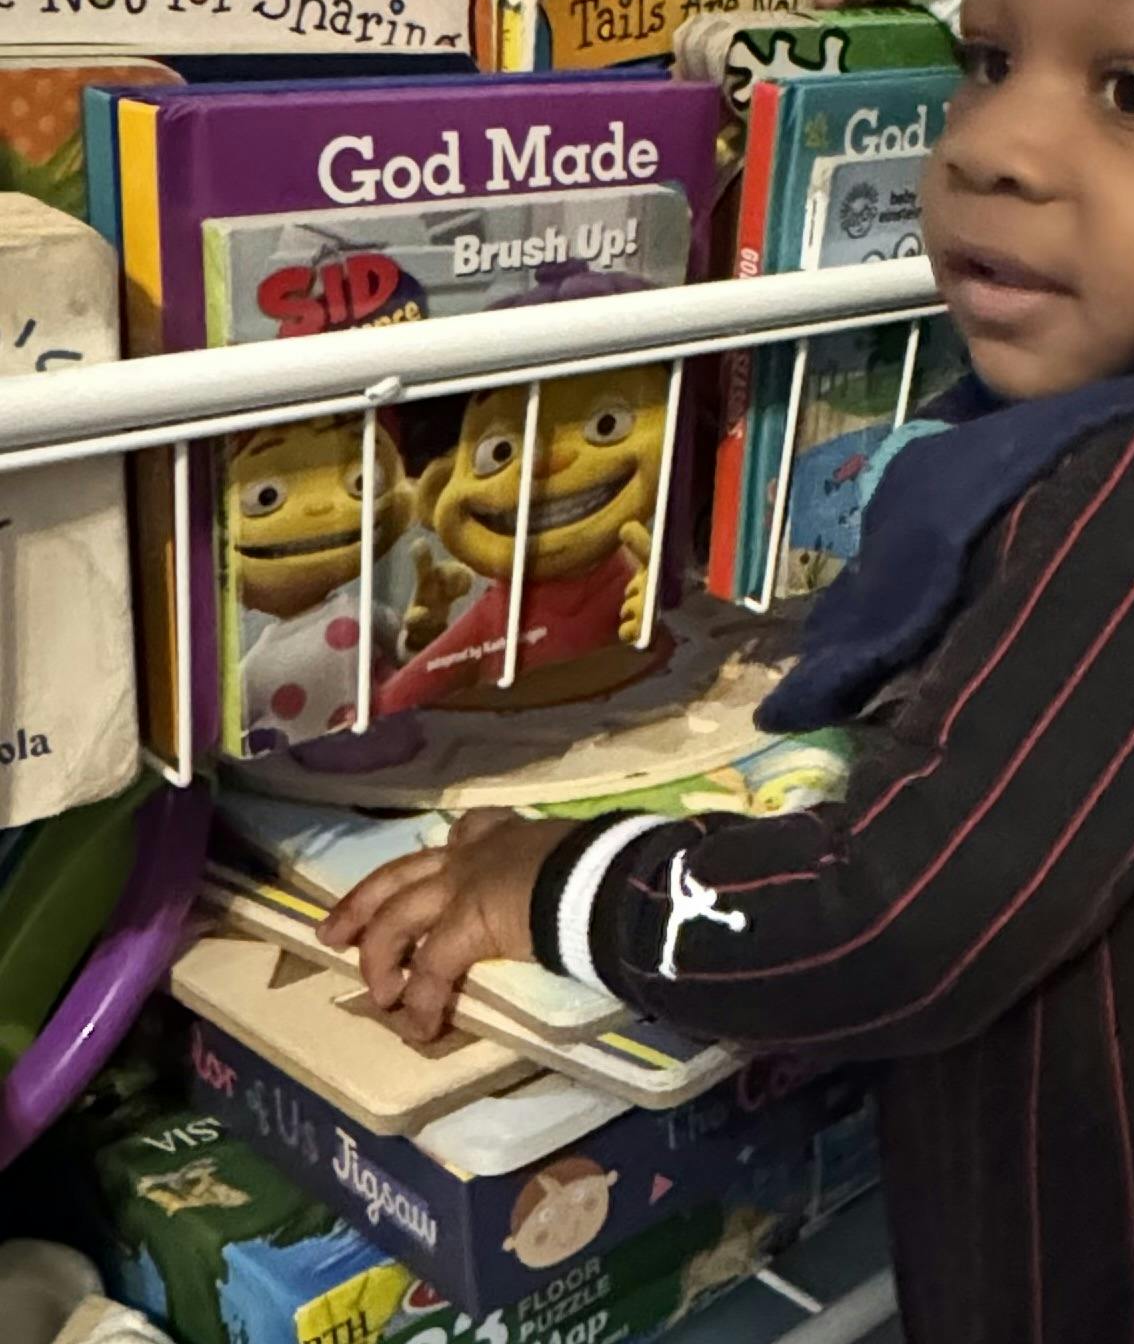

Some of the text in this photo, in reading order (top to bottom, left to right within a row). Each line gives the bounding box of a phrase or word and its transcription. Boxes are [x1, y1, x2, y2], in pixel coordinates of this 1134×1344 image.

[844, 104, 931, 156] God
[318, 121, 660, 204] God Made
[453, 217, 640, 277] Brush Up!
[257, 252, 399, 338] SID
[0, 728, 53, 765] ola
[143, 1117, 223, 1154] VIS
[332, 1126, 438, 1246] Jigsaw
[518, 1257, 600, 1320] FLOOR
[519, 1275, 611, 1344] PUZZLE
